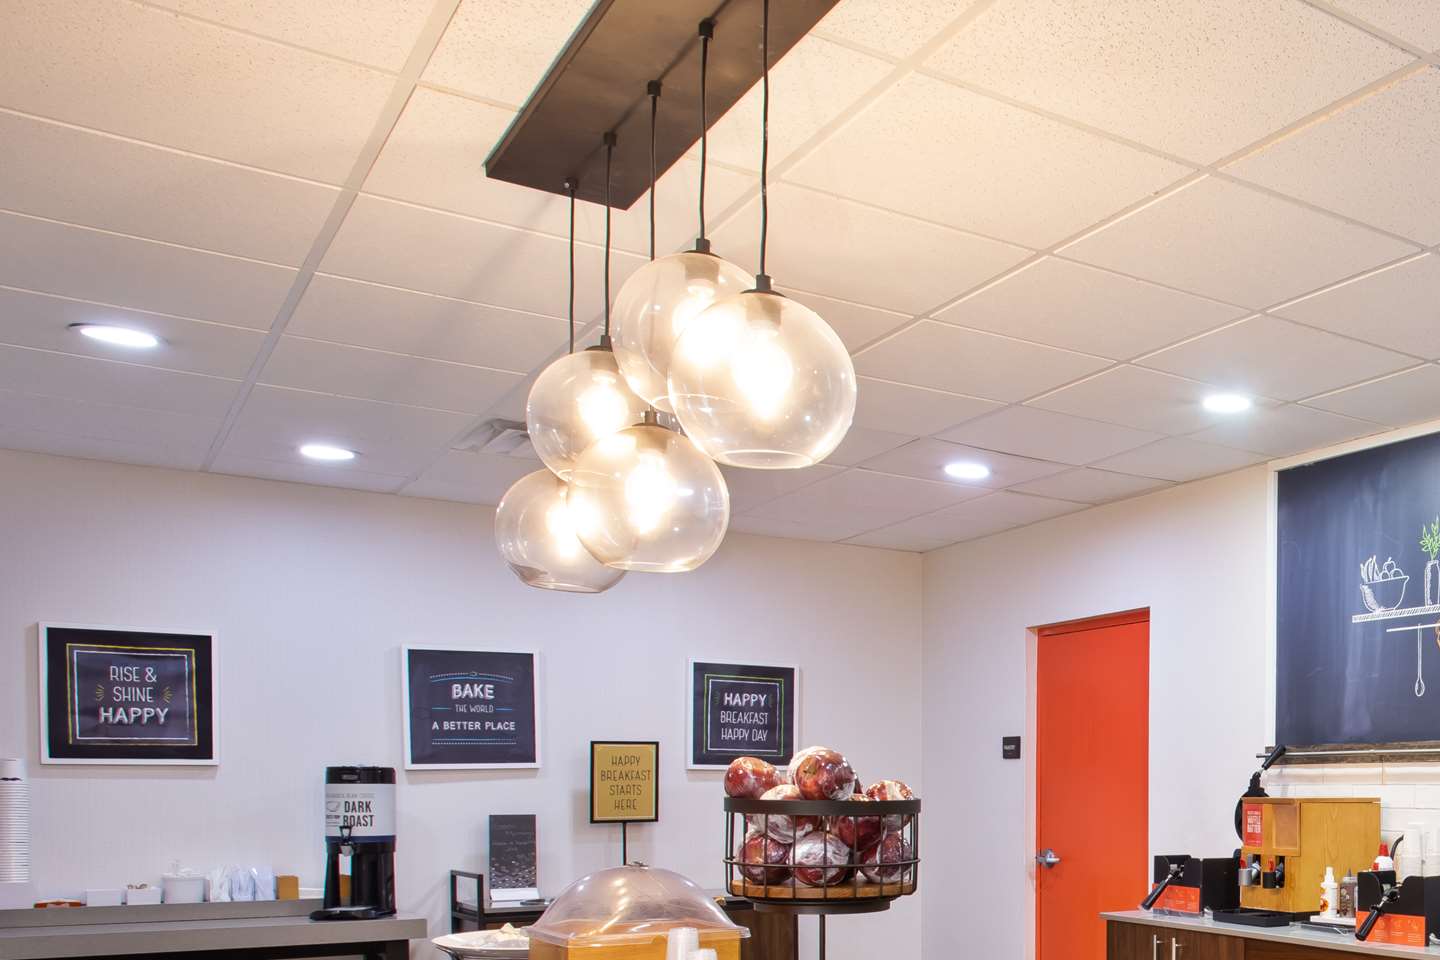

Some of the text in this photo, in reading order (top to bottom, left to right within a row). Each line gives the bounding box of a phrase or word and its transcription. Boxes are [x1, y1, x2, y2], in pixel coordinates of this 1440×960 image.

[109, 665, 157, 683] RISE &
[112, 686, 154, 703] SHINE
[451, 683, 495, 699] BAKE
[723, 692, 768, 707] HAPPY
[455, 704, 494, 713] THE WORLD
[99, 706, 169, 725] HAPPY
[720, 710, 768, 725] BREAKFAST
[431, 721, 516, 731] A BETTER PLACE
[721, 727, 768, 742] HAPPY DAY
[611, 755, 641, 766] HAPPY
[600, 769, 652, 782] BREAKFAST
[609, 784, 642, 796] STARTS
[344, 800, 372, 813] DARK
[614, 798, 637, 811] HERE
[342, 814, 375, 827] ROAST
